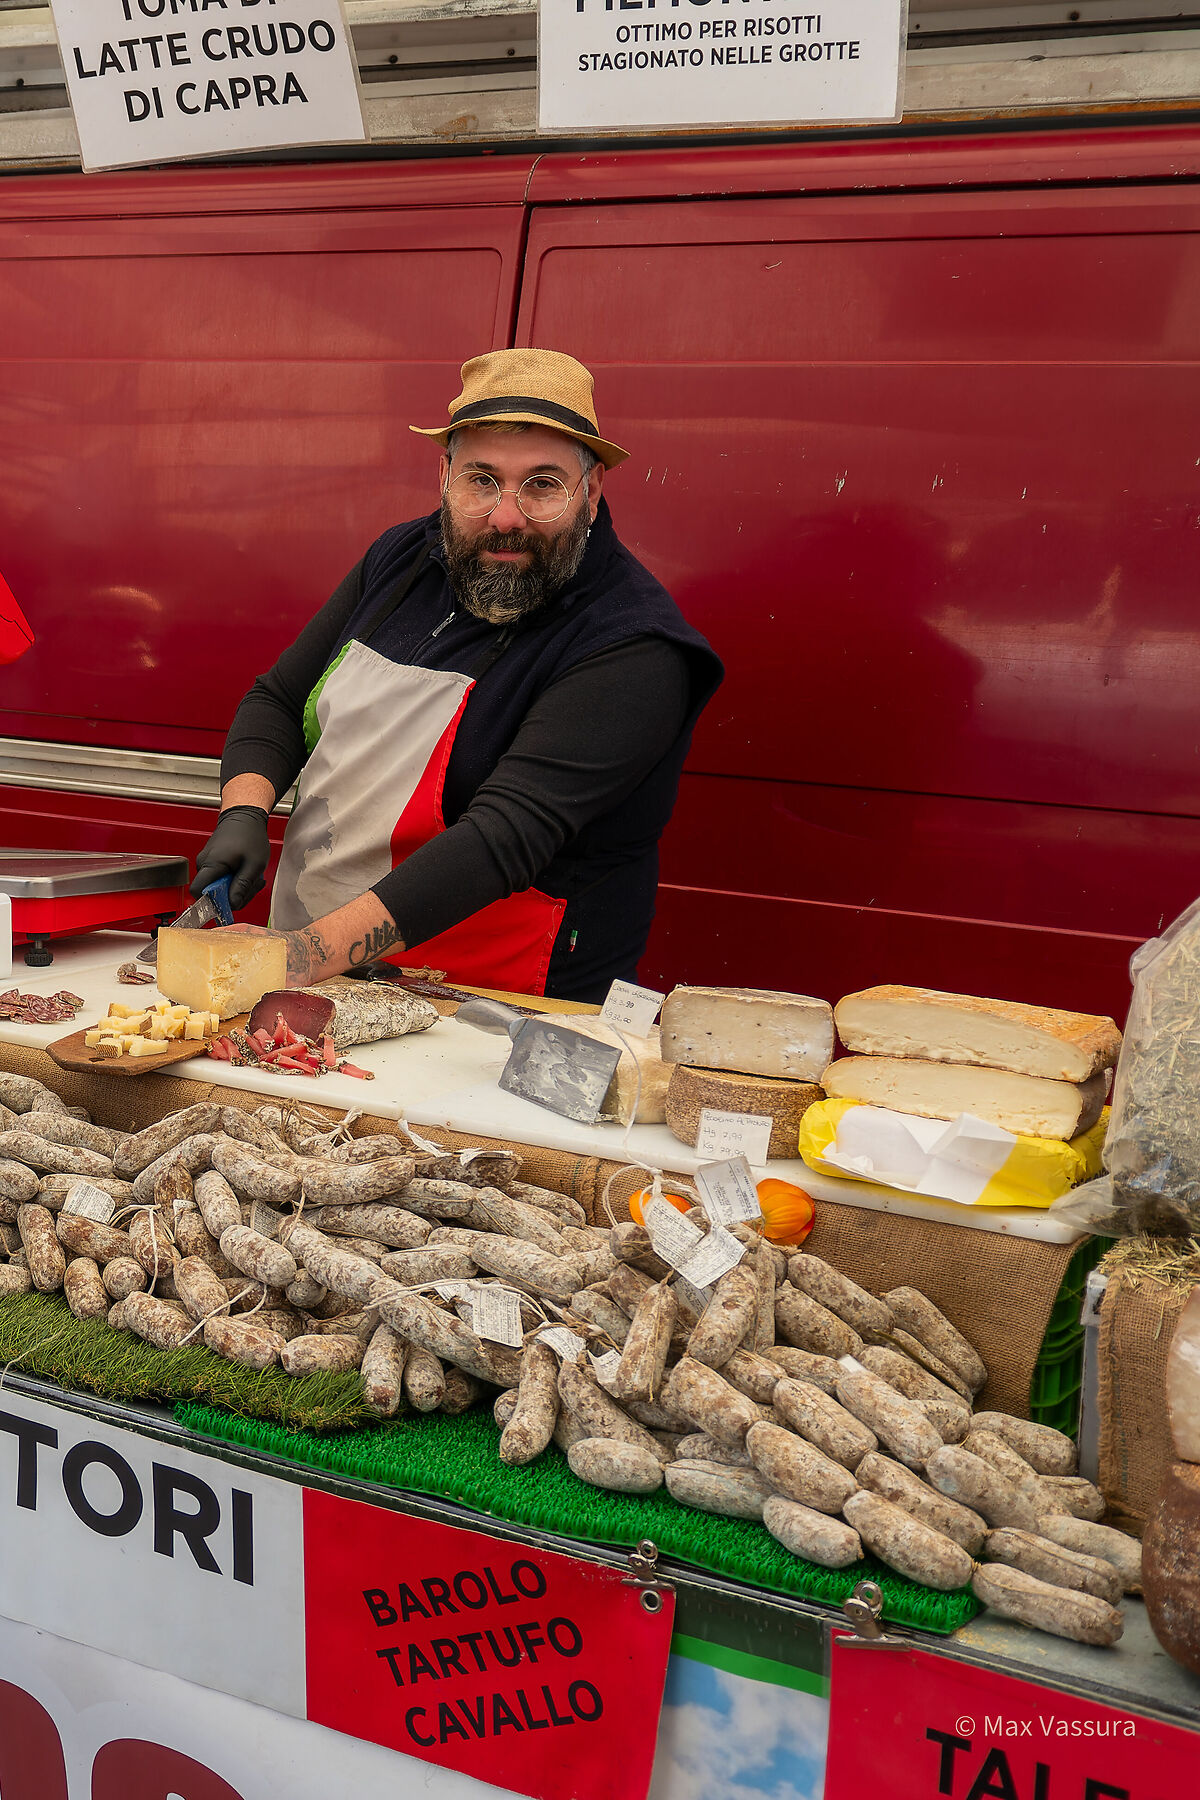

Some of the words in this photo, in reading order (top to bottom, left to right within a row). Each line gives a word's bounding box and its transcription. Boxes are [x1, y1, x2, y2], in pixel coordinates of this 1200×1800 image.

[73, 32, 192, 79] LATTE
[201, 19, 337, 61] CRUDO
[578, 49, 704, 72] STAGIONATO
[710, 45, 772, 66] NELLE
[779, 40, 861, 62] GROTTE
[615, 22, 693, 44] OTTIMO
[699, 19, 737, 39] PER
[743, 15, 822, 37] RISOTTI
[123, 86, 164, 122] DI
[176, 72, 309, 115] CAPRA
[362, 1559, 547, 1627] BAROLO
[376, 1617, 583, 1687] TARTUFO
[404, 1679, 604, 1747] CAVALLO
